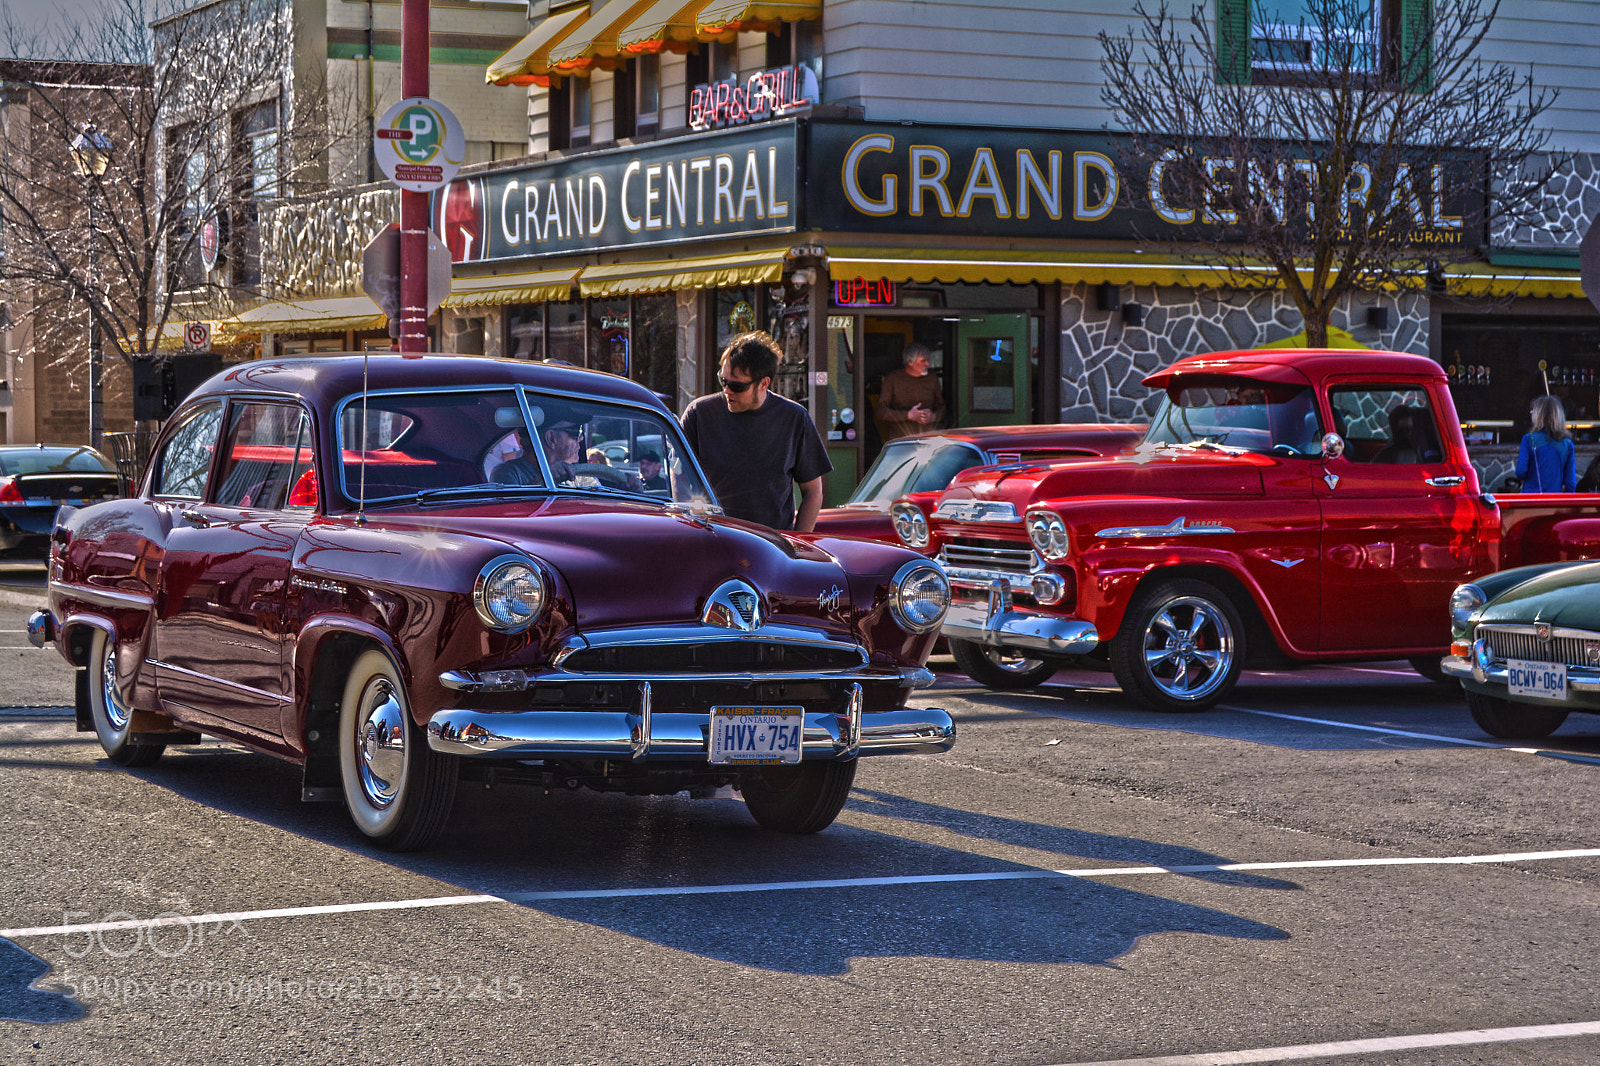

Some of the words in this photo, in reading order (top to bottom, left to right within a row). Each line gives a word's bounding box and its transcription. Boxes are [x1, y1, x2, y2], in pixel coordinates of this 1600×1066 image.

[409, 114, 433, 145] P
[841, 133, 1120, 221] GRAND
[1148, 147, 1464, 227] CENTRAL
[500, 172, 608, 247] GRAND
[621, 146, 788, 234] CENTRAL
[838, 276, 892, 303] OPEN
[827, 316, 852, 328] 4573
[1510, 668, 1537, 688] BCWV
[1543, 672, 1564, 691] 064
[740, 715, 777, 725] ONTARIO
[724, 724, 757, 751] HVX
[768, 724, 800, 751] 754
